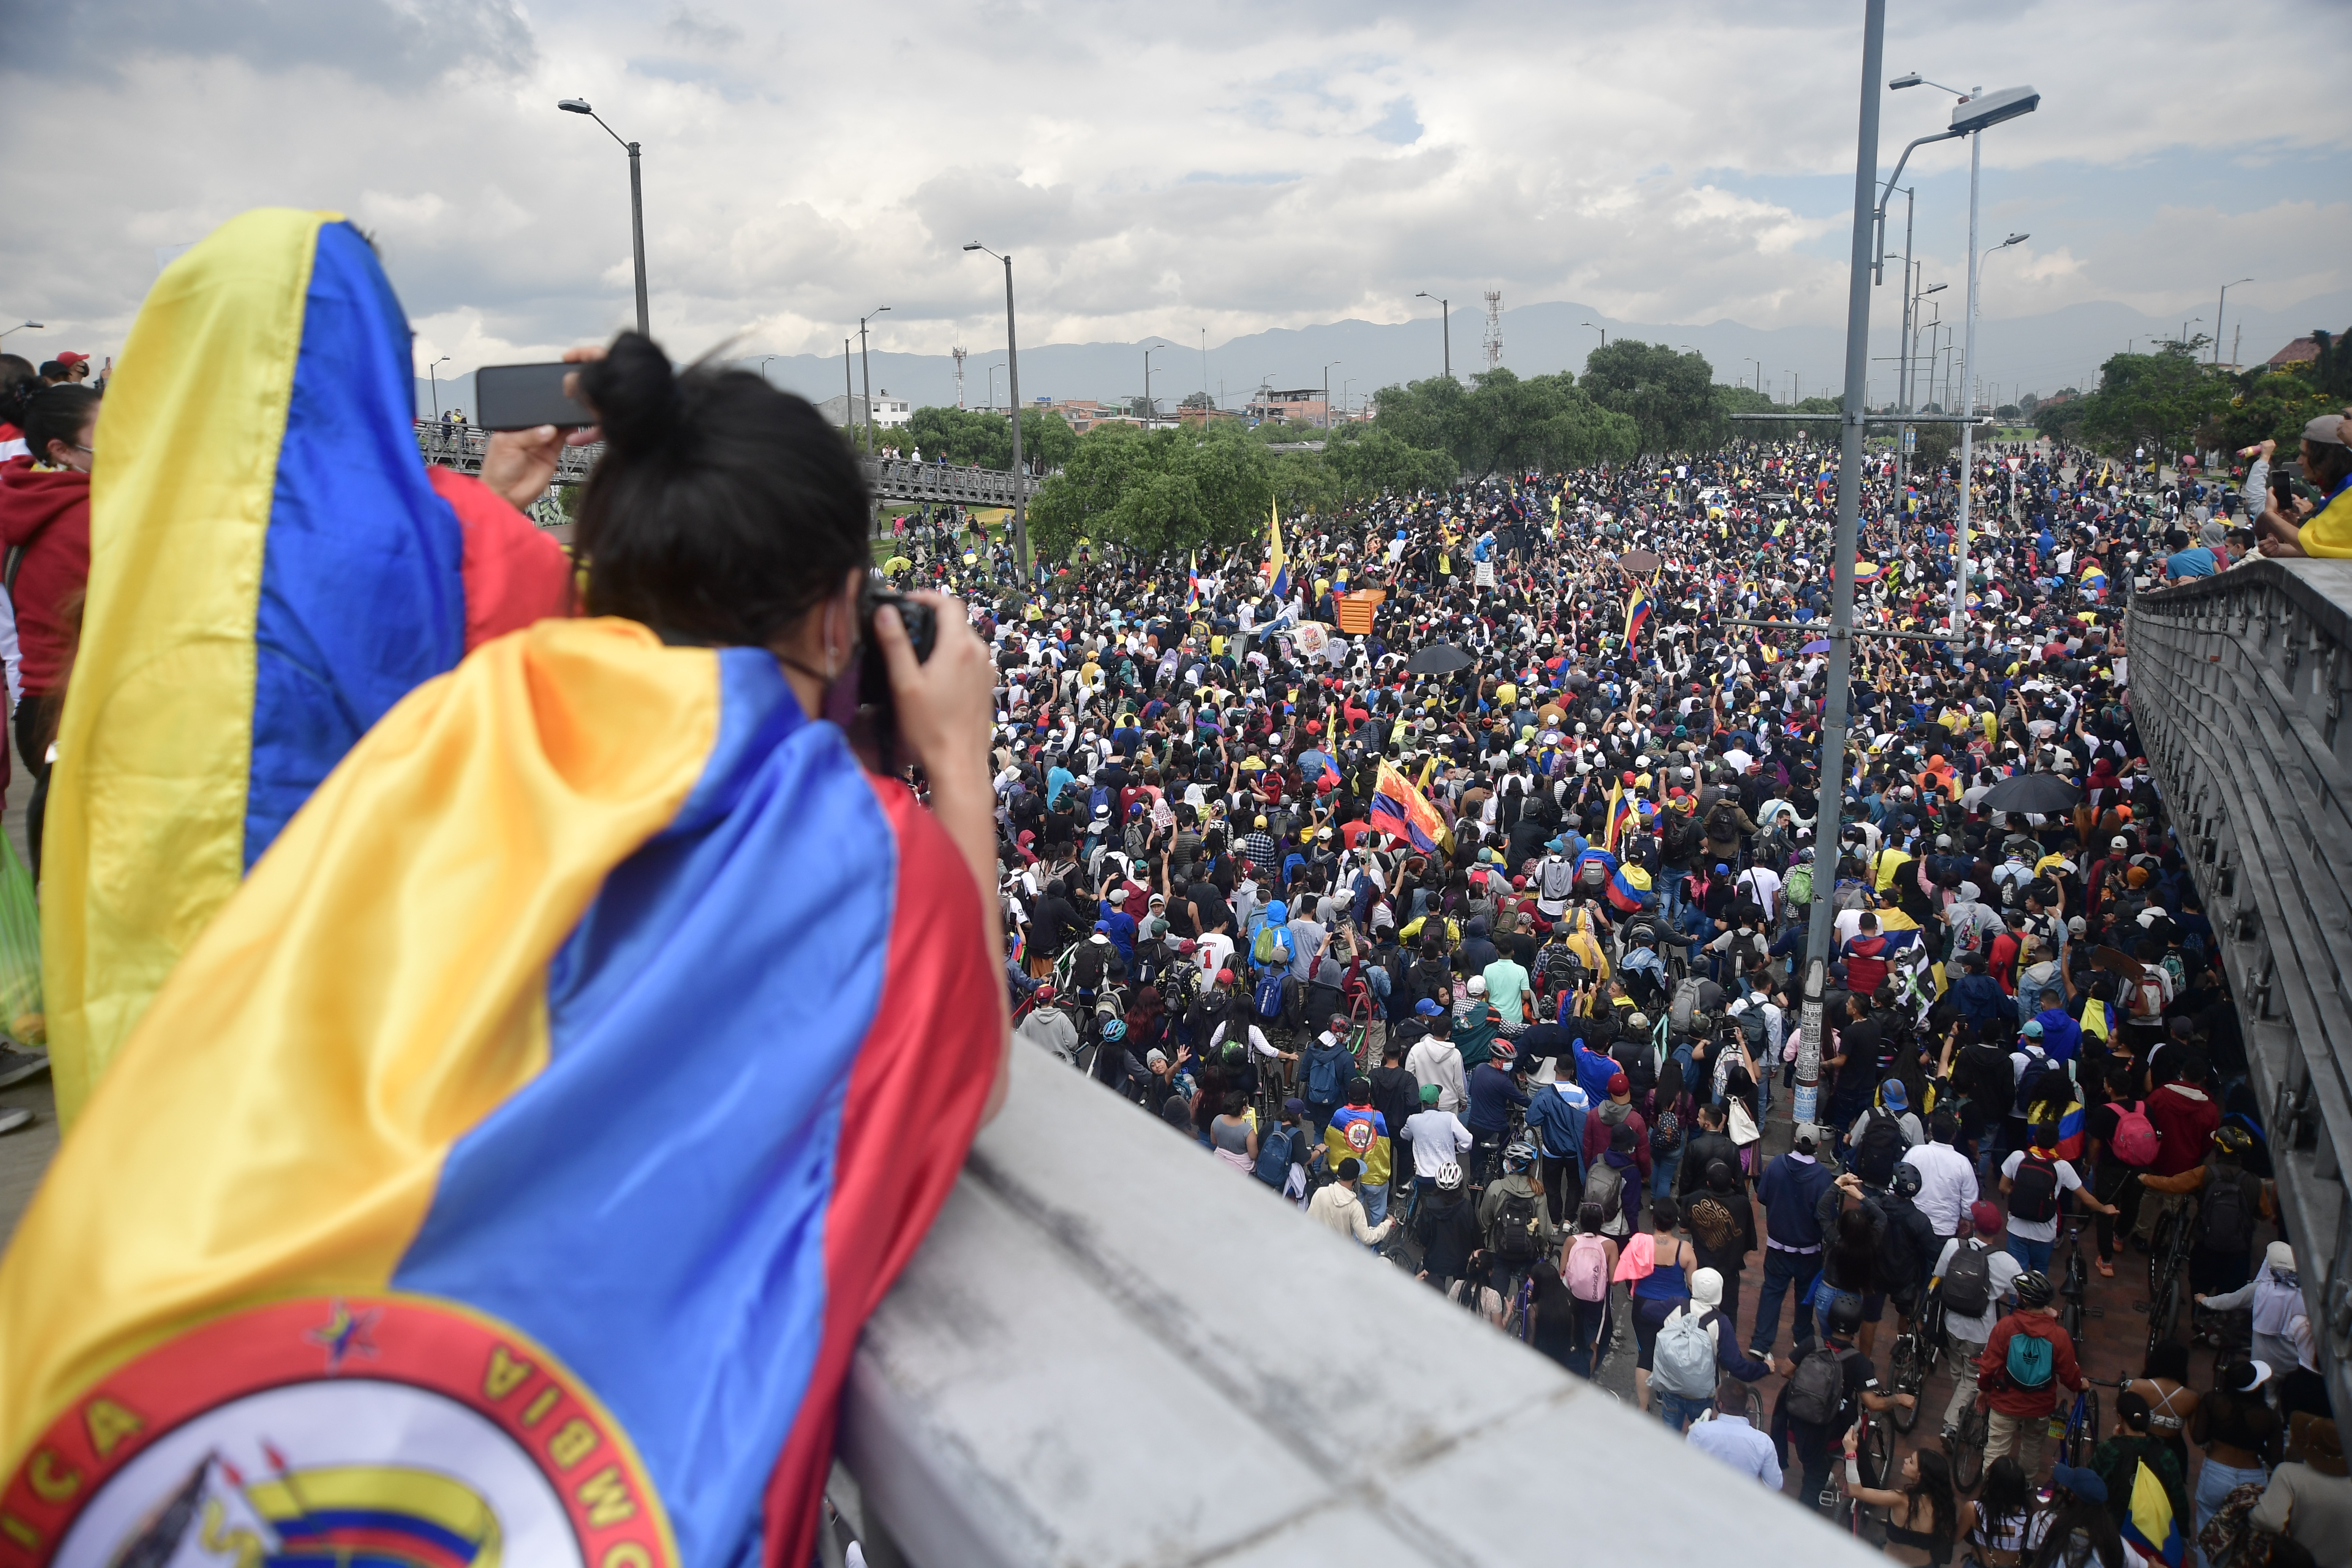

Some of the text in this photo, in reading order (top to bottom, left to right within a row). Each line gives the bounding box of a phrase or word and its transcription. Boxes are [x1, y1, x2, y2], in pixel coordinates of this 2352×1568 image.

[1155, 812, 1172, 820] RESPIRA
[1157, 817, 1173, 828] LUCHA
[1203, 950, 1212, 969] 1
